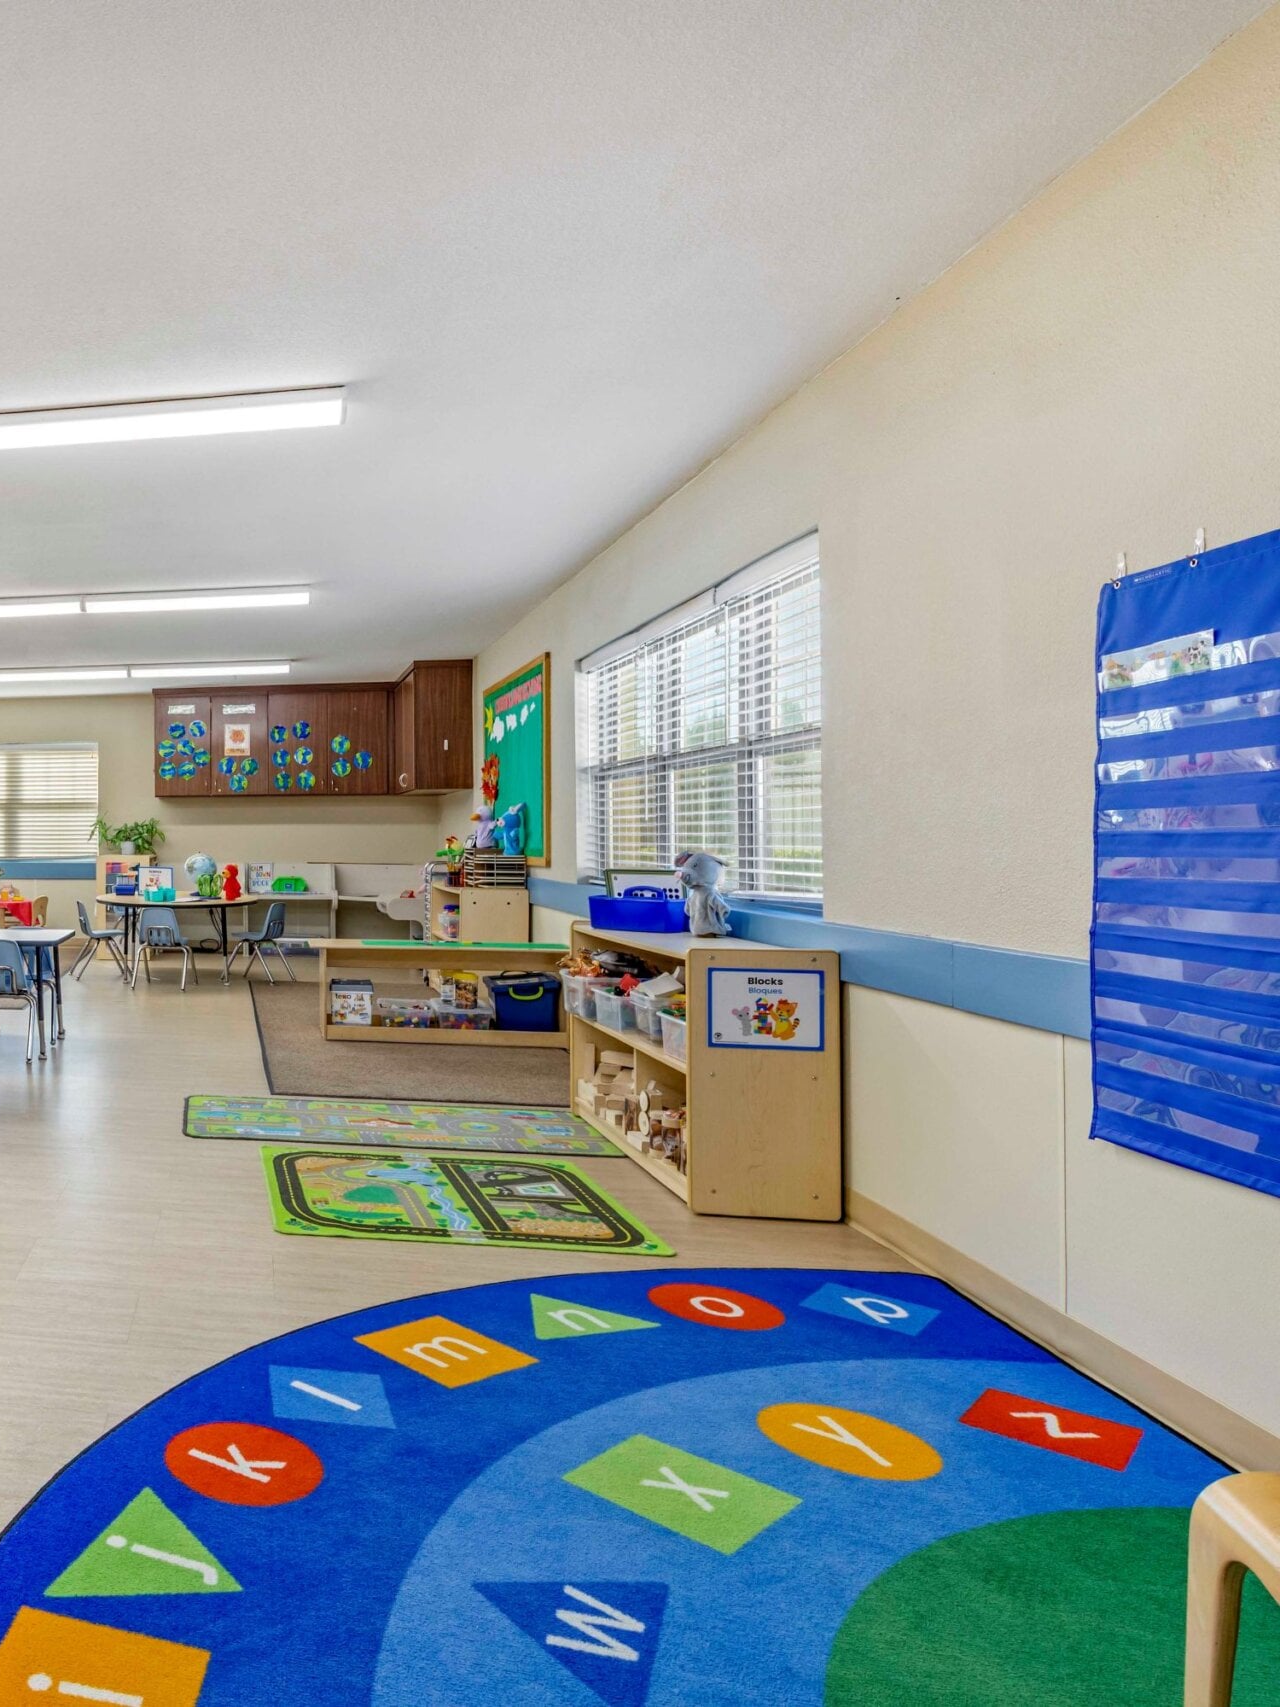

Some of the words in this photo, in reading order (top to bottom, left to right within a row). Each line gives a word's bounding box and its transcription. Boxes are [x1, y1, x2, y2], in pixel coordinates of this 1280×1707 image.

[747, 977, 784, 985] Blocks
[748, 987, 782, 995] Bloques
[549, 1309, 611, 1332] n
[689, 1295, 745, 1319] o
[842, 1297, 909, 1325] p
[403, 1336, 488, 1369] m
[792, 1415, 893, 1468] y
[187, 1443, 288, 1484] k
[640, 1466, 731, 1513] x
[106, 1534, 219, 1586] j
[26, 1672, 144, 1707] i
